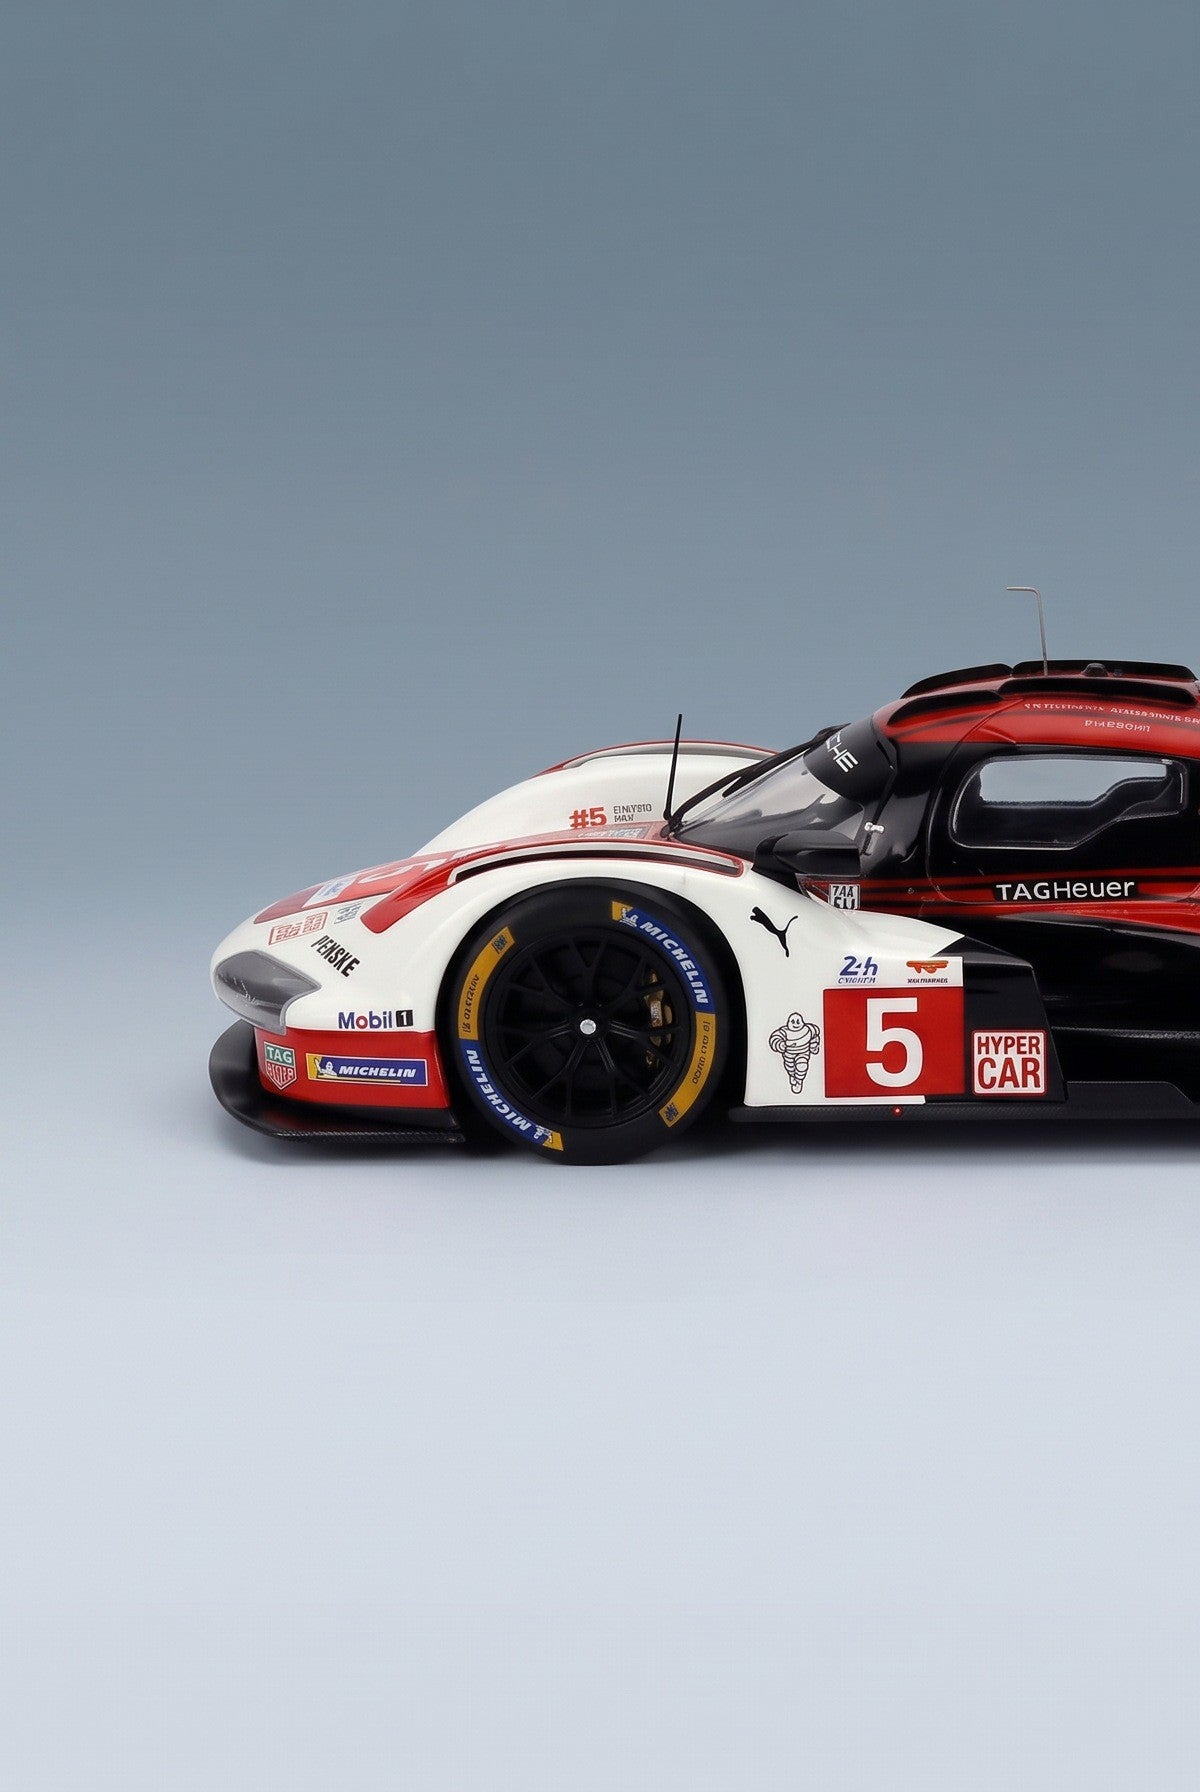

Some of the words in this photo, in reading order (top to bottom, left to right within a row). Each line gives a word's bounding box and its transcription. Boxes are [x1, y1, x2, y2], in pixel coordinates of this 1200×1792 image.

[568, 806, 608, 828] #5
[310, 934, 361, 978] PENSKE
[639, 920, 709, 1004] MICHELIN
[338, 1010, 393, 1029] Mobil
[266, 1046, 293, 1064] TAG
[865, 997, 924, 1088] 5
[977, 1036, 1041, 1055] HYPER
[338, 1065, 417, 1078] MICHELIN
[977, 1057, 1041, 1089] CAR
[465, 1049, 533, 1132] MICHELIN
